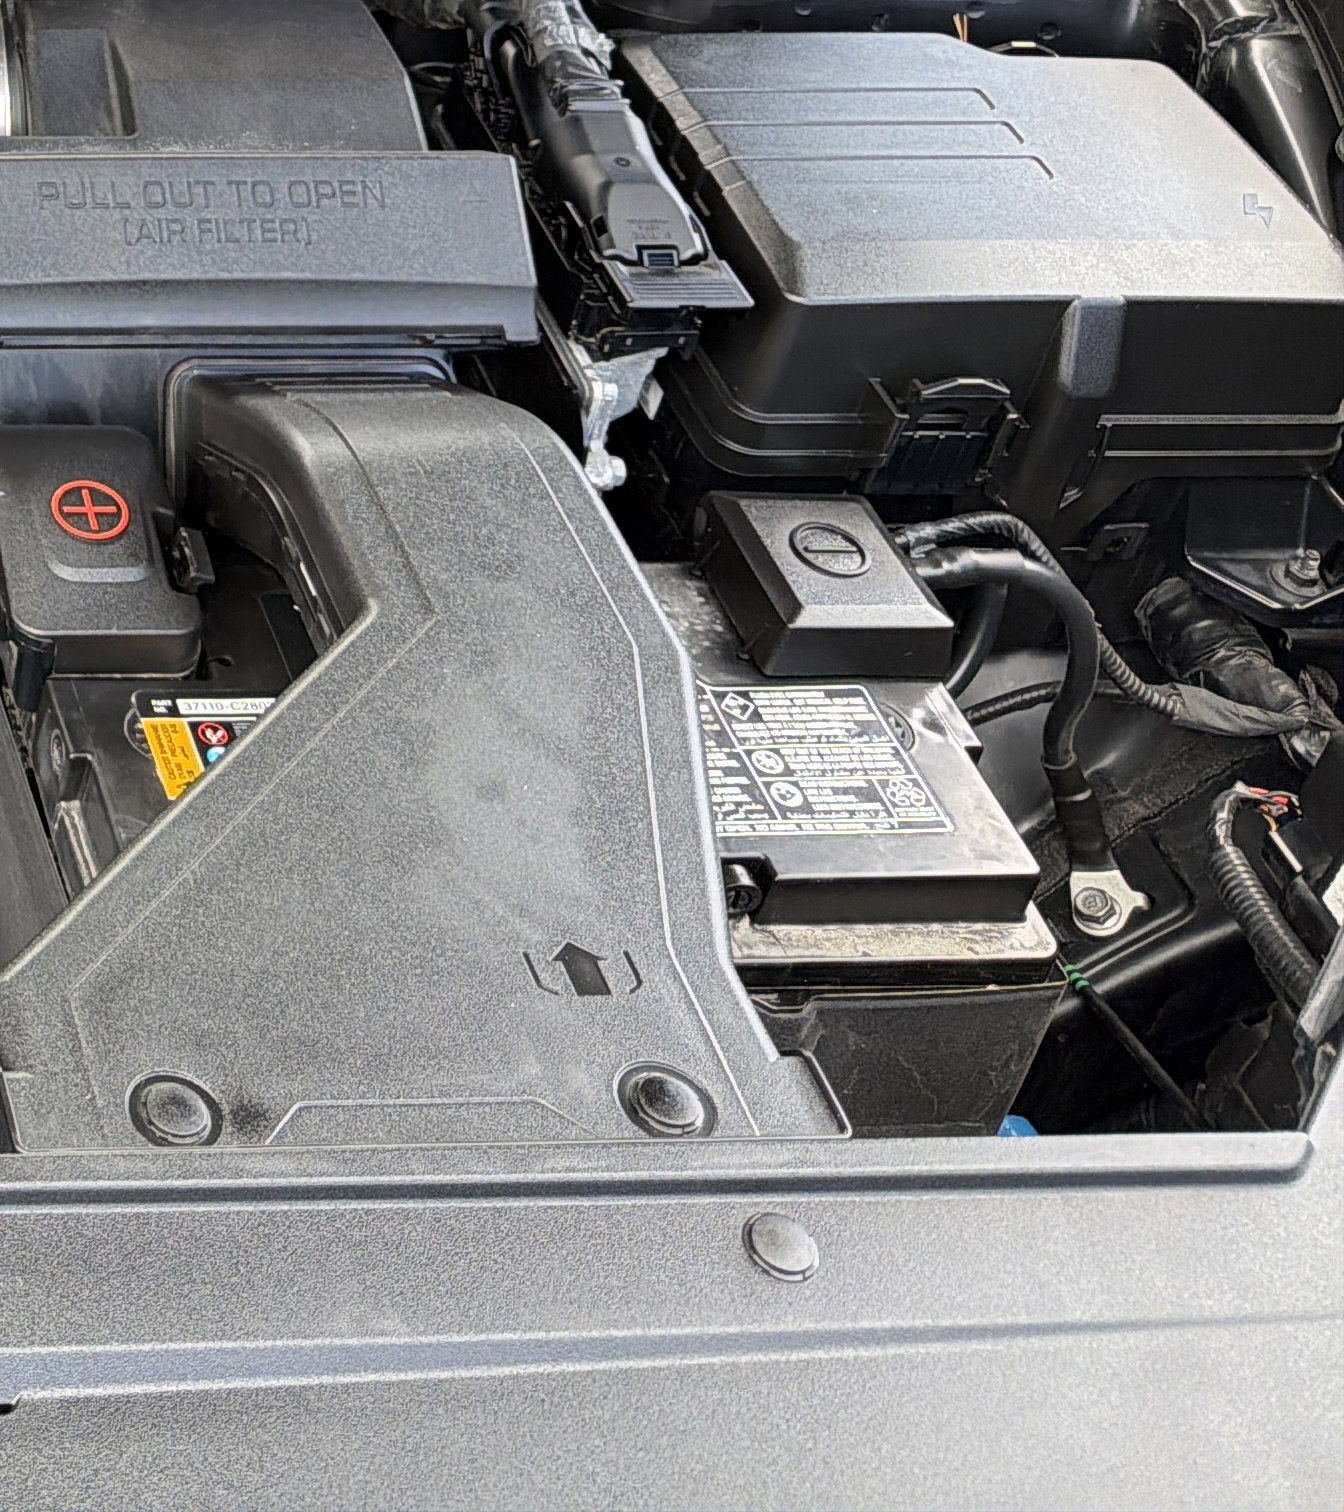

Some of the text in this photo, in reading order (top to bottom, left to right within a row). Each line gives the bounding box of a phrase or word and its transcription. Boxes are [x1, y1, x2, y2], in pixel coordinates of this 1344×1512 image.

[38, 178, 385, 210] PULL OUT TO OPEN
[183, 701, 274, 712] 37110-C280
